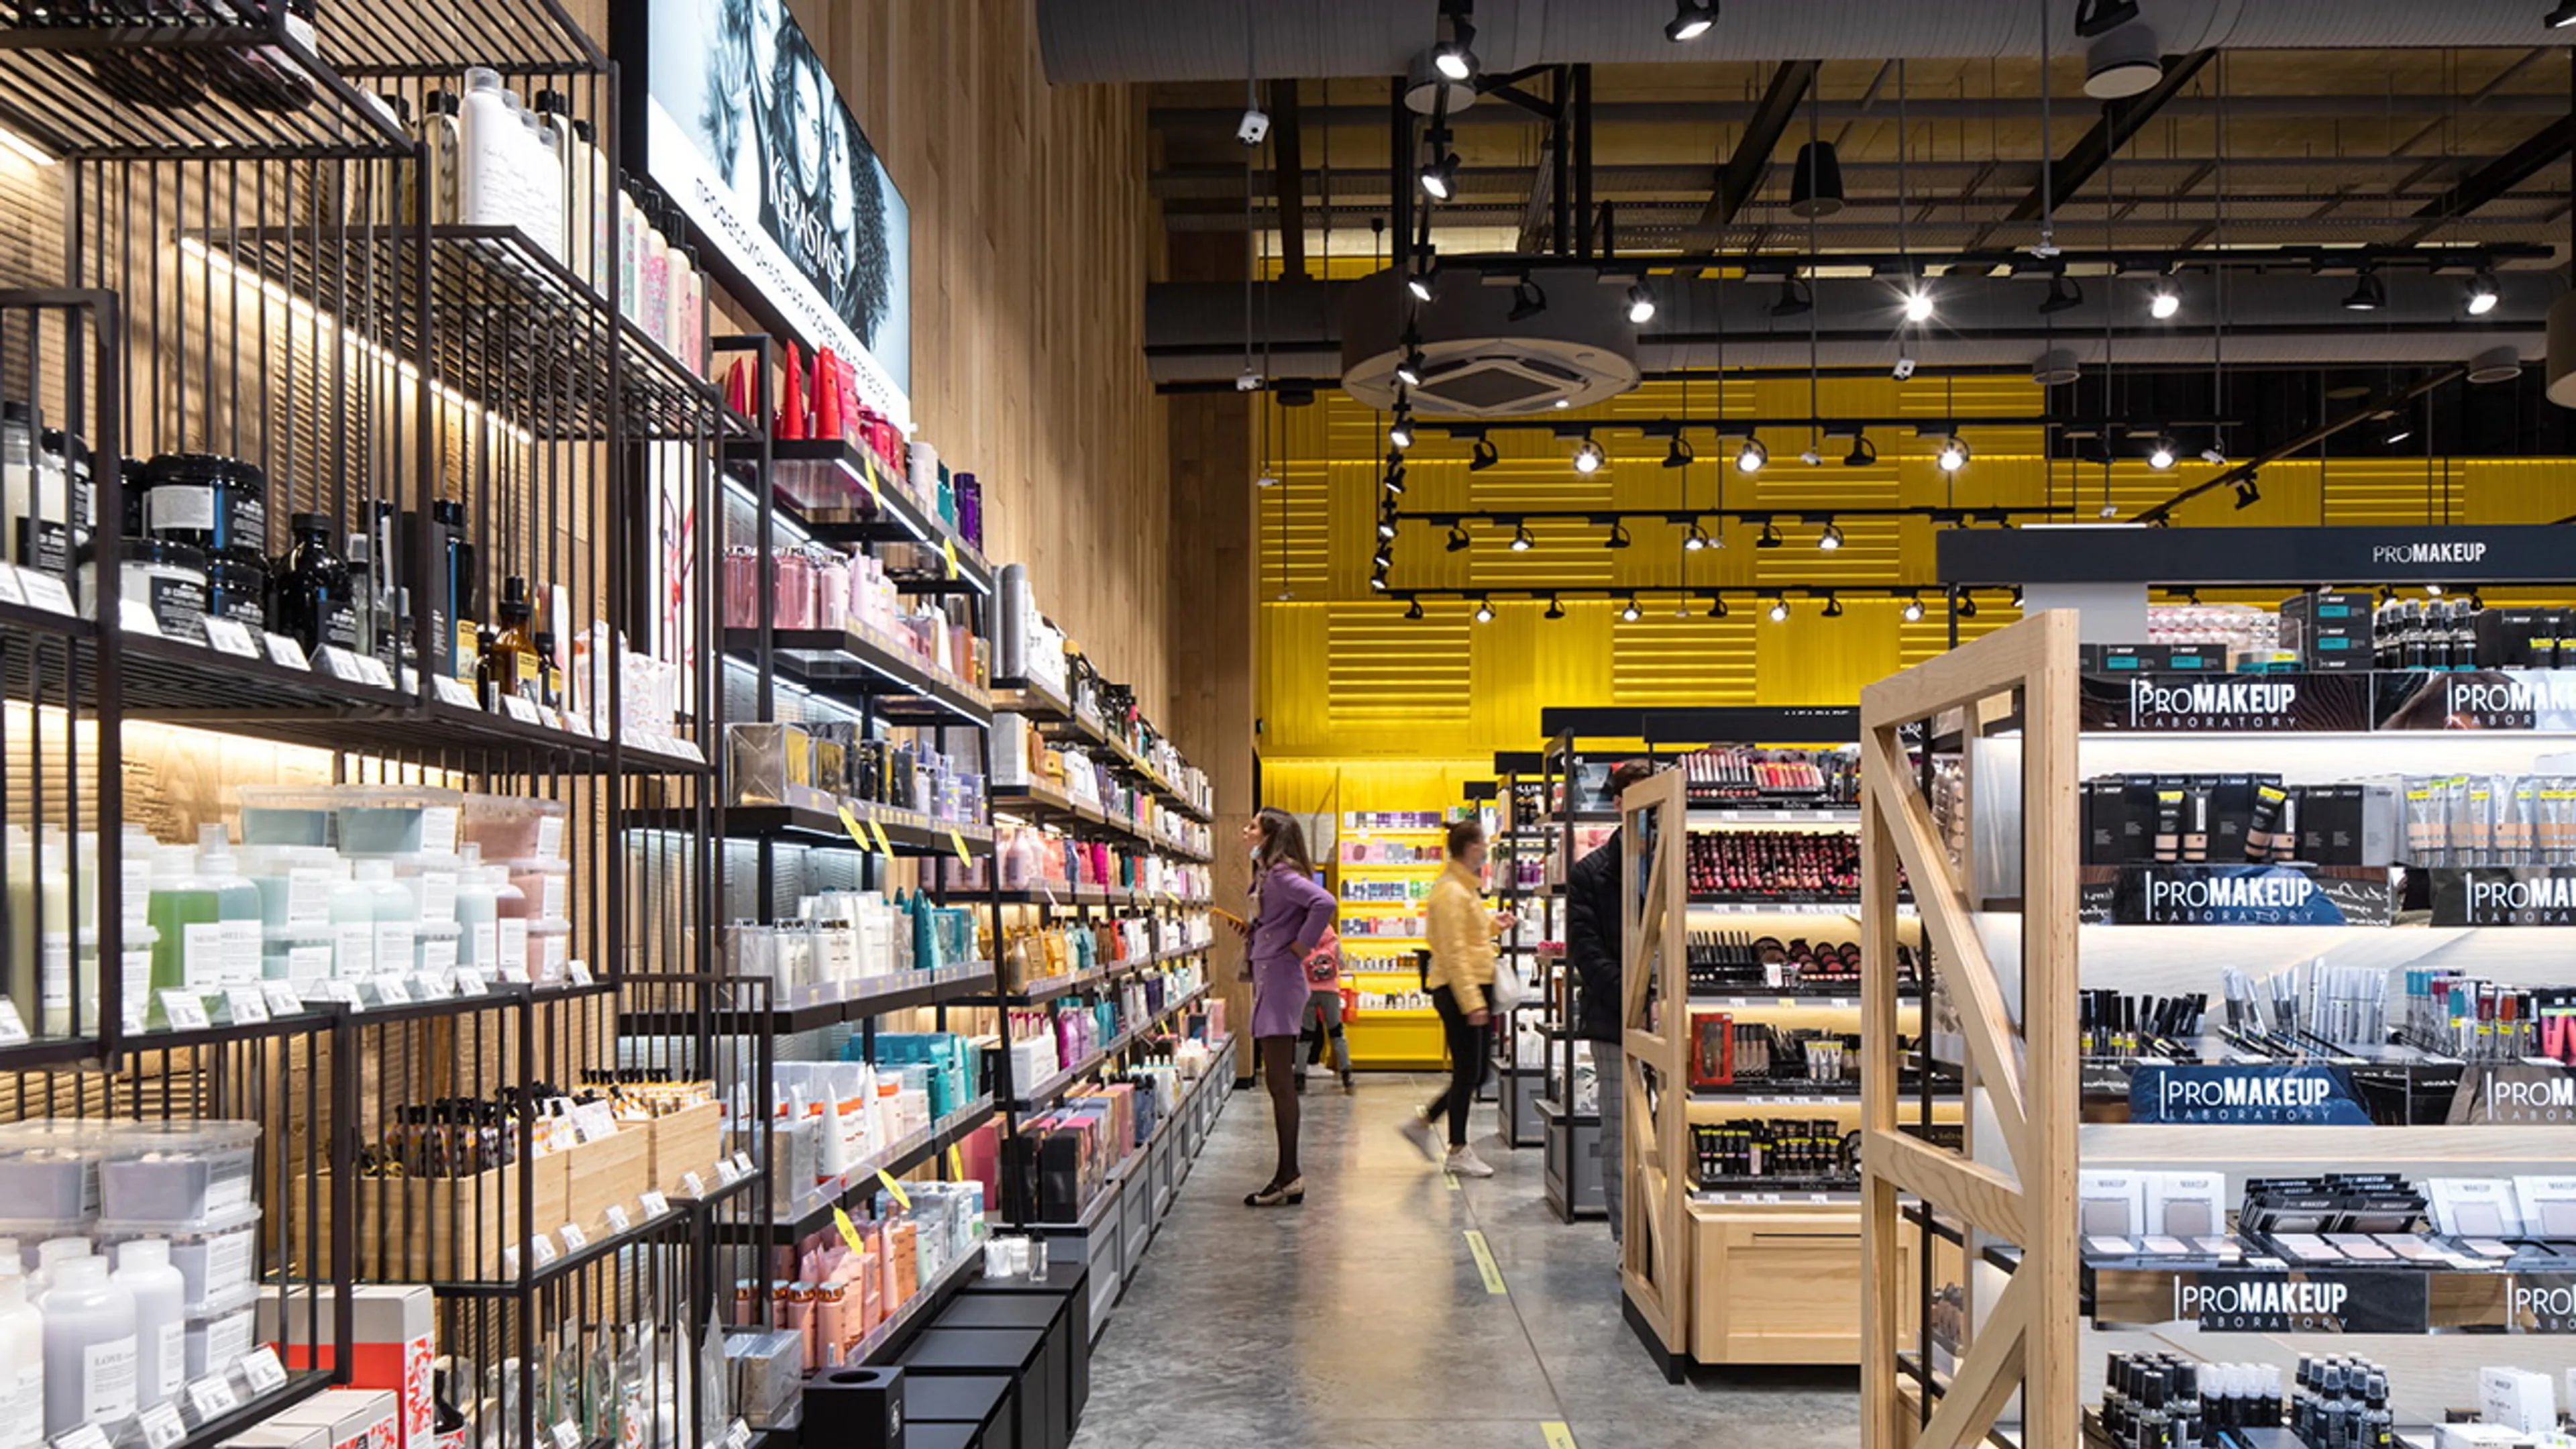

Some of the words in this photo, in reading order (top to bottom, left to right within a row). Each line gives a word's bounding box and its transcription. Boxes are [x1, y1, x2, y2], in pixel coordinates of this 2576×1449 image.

[2373, 543, 2487, 563] PROMAKEUP
[2139, 684, 2296, 714] PROMAKEUP
[2139, 716, 2297, 728] LABORATORY
[2154, 877, 2312, 907] PROMAKEUP
[2155, 910, 2314, 922] LABORATORY
[2168, 1077, 2330, 1106] PROMAKEUP
[2169, 1109, 2330, 1121] LABORATORY
[2182, 1282, 2347, 1313] PROMAKEUP
[2515, 1284, 2576, 1315] PRO
[2184, 1316, 2348, 1329] ABORATORY
